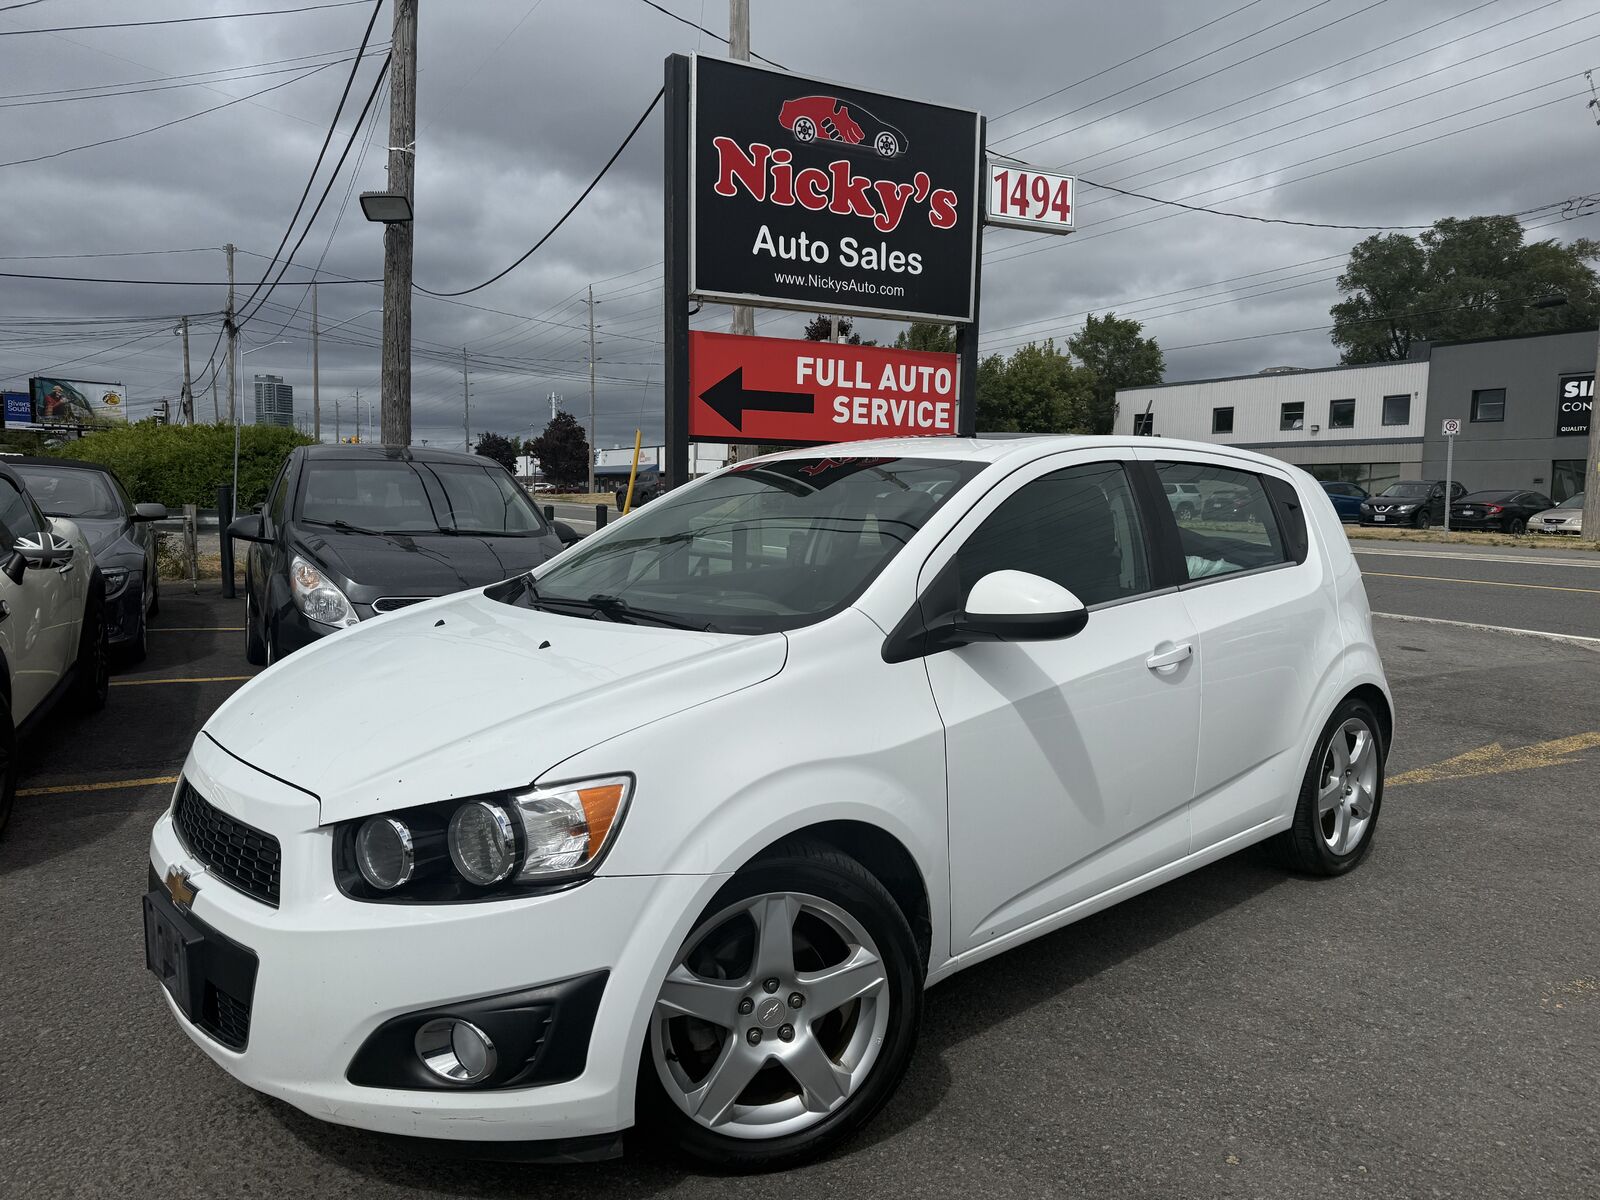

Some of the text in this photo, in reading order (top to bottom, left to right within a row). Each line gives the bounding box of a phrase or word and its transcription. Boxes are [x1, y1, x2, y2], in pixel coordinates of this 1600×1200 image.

[713, 136, 958, 233] Nicky's
[993, 169, 1071, 222] 1494
[752, 224, 923, 275] Auto Sales
[774, 272, 905, 297] www.NickysAuto.com
[796, 356, 952, 395] FULL AUTO
[832, 396, 951, 429] SERVICE
